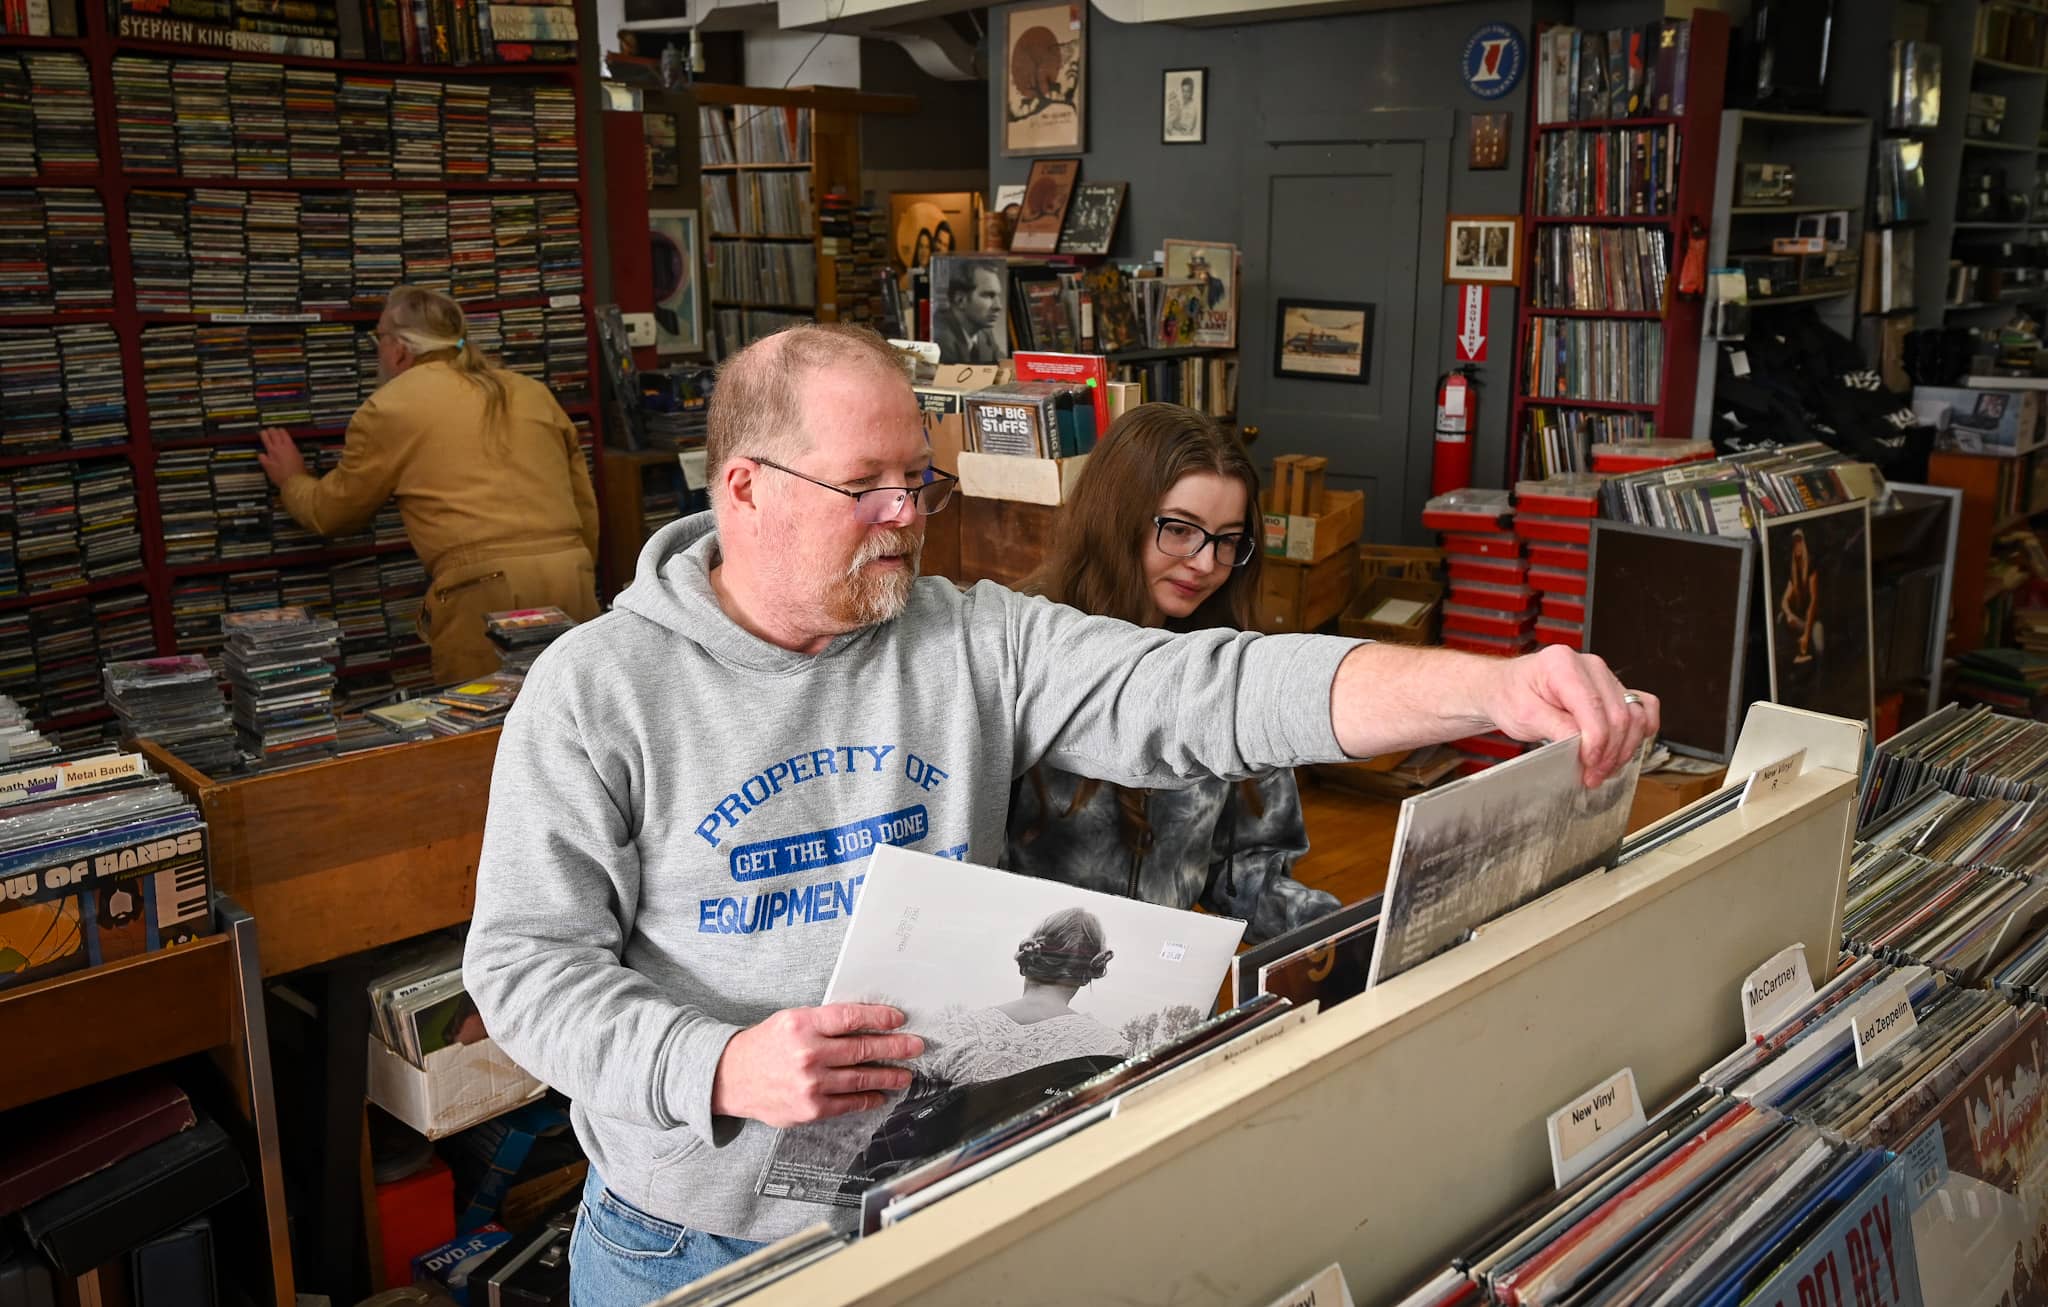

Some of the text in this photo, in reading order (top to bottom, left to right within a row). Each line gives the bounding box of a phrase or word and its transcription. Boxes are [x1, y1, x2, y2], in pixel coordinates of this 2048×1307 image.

[120, 19, 233, 47] STEPHEN KING
[979, 406, 1028, 420] TEN BIG
[67, 763, 136, 783] Metal Bands
[694, 744, 949, 849] PROPERTY OF
[44, 860, 89, 890] OF
[95, 831, 203, 878] HANDS
[734, 811, 926, 876] GET THE JOB DONE
[1748, 964, 1797, 1008] McCartney
[1859, 1001, 1909, 1047] Led Zeppelin
[1572, 1087, 1616, 1126] New Vinyl
[1594, 1118, 1603, 1132] L
[424, 1239, 488, 1273] DVD-R
[1845, 1192, 1900, 1307] REY
